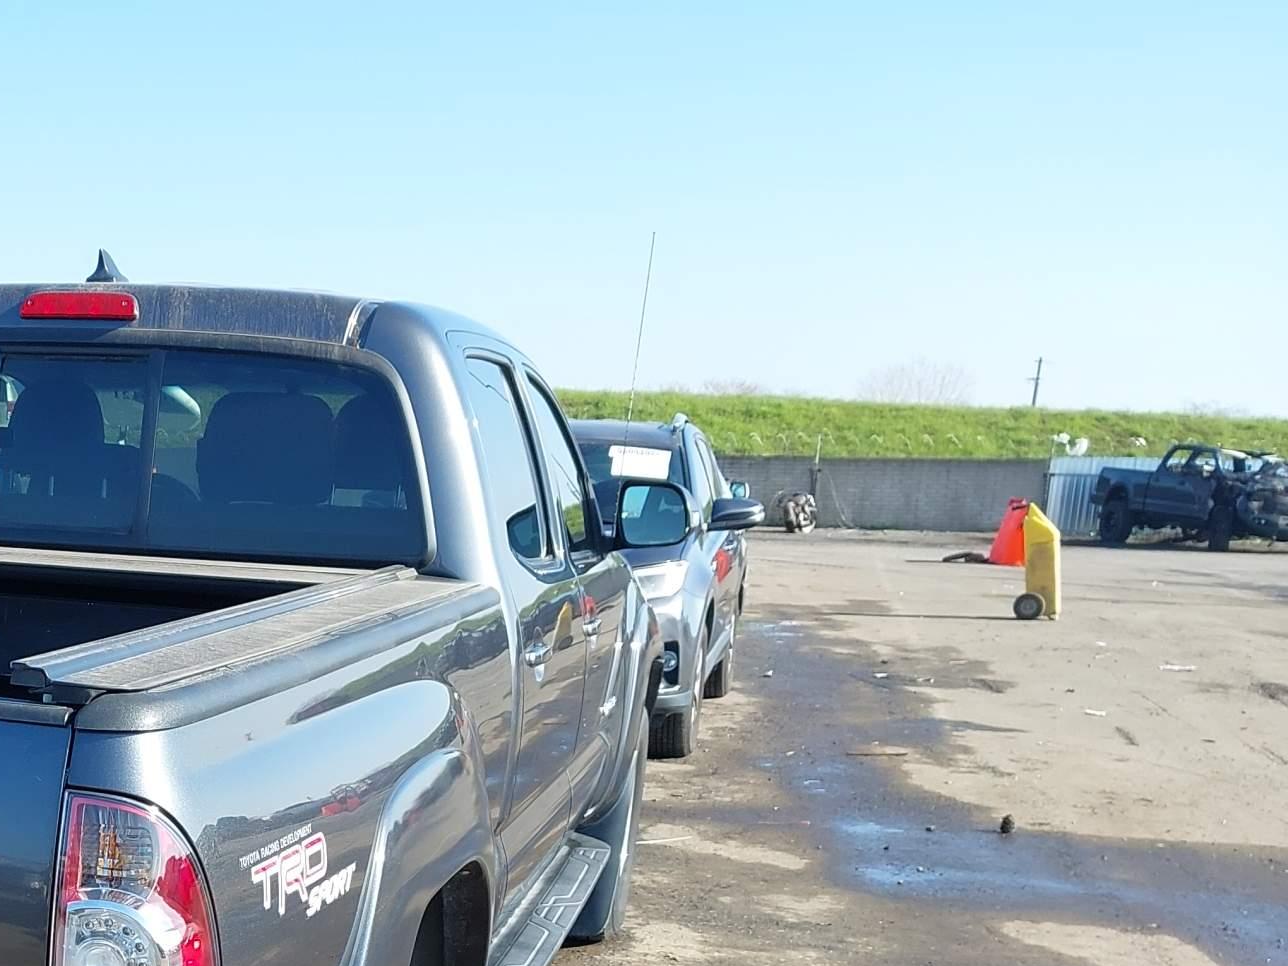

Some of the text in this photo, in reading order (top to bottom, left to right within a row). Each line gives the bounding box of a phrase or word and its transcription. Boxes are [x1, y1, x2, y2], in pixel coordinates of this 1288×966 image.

[239, 823, 313, 870] TOYOTA RACING DEVELOPMENT
[251, 831, 328, 917] TRD
[305, 861, 357, 918] SPORT
